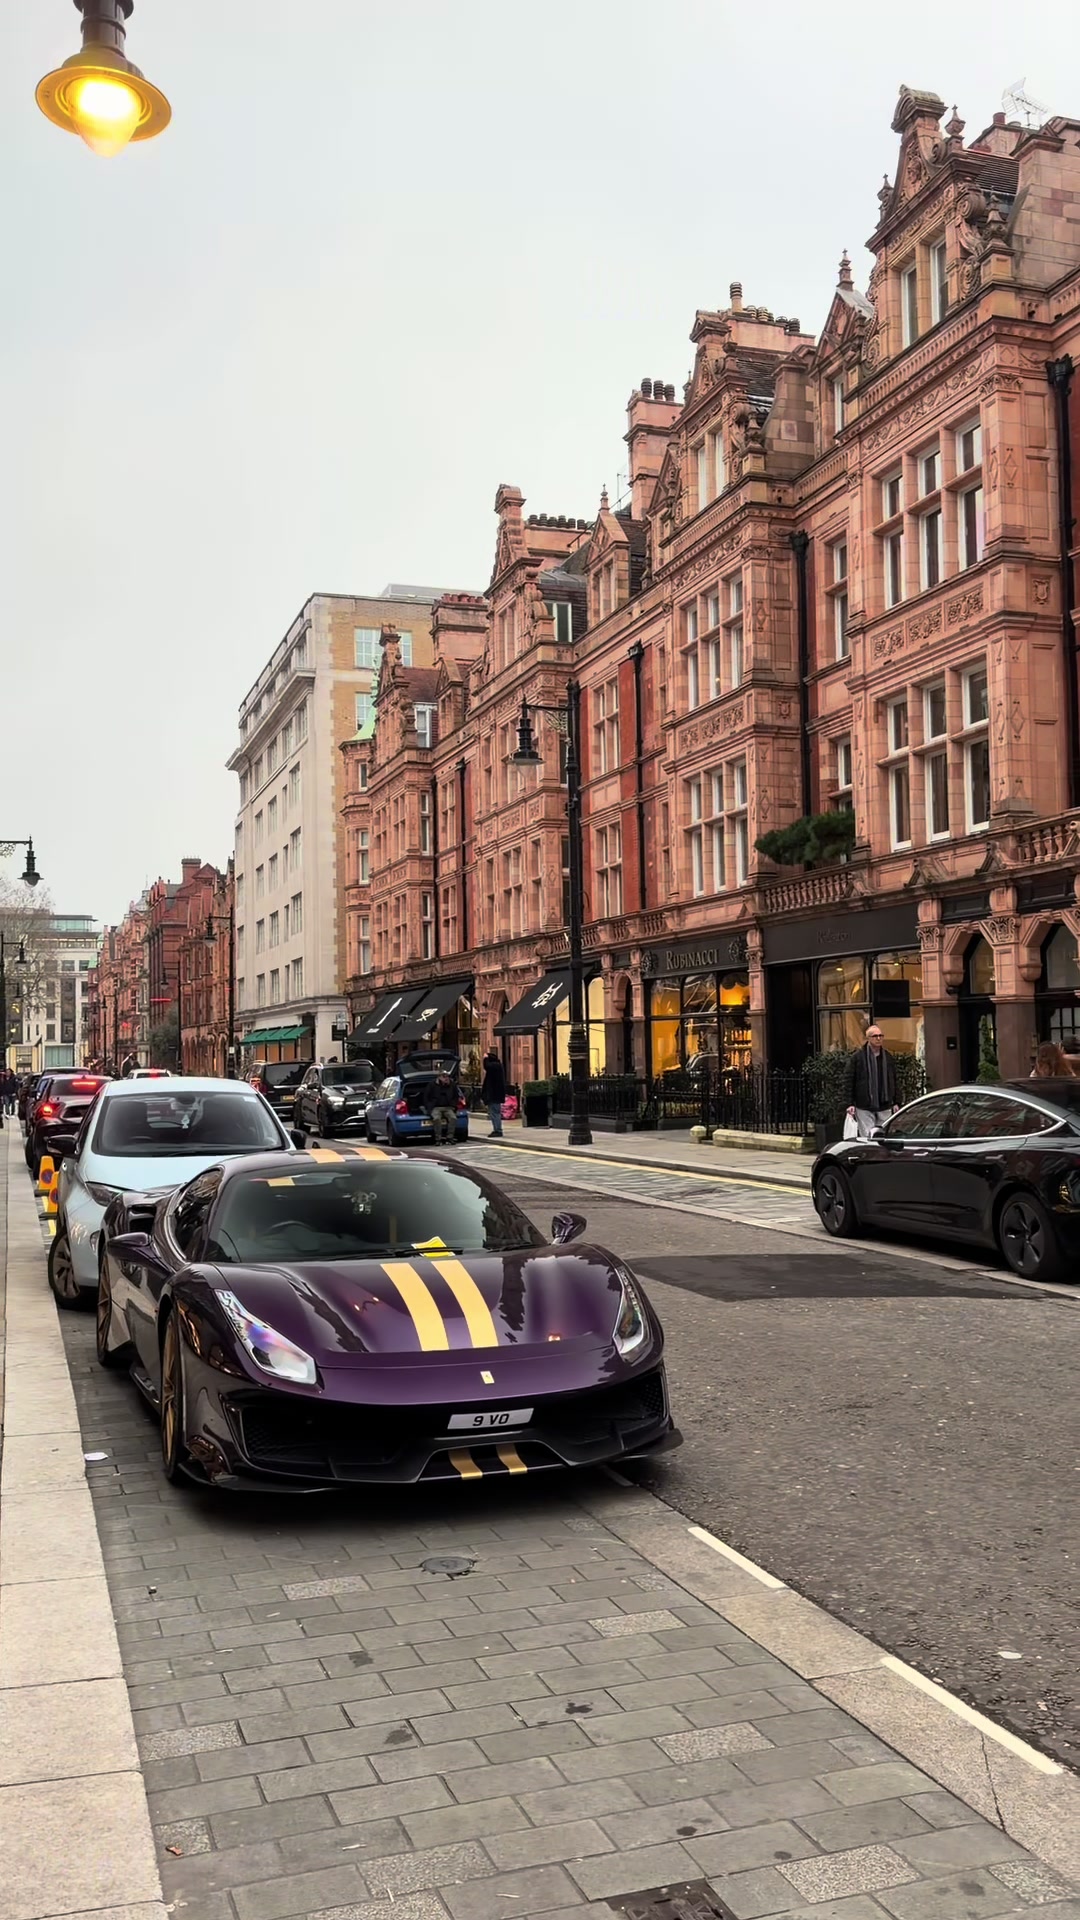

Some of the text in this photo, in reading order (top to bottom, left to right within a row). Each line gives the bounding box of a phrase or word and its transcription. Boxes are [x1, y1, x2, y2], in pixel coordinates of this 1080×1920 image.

[667, 949, 718, 970] RUBINACCI
[473, 1413, 509, 1426] 9 VO
